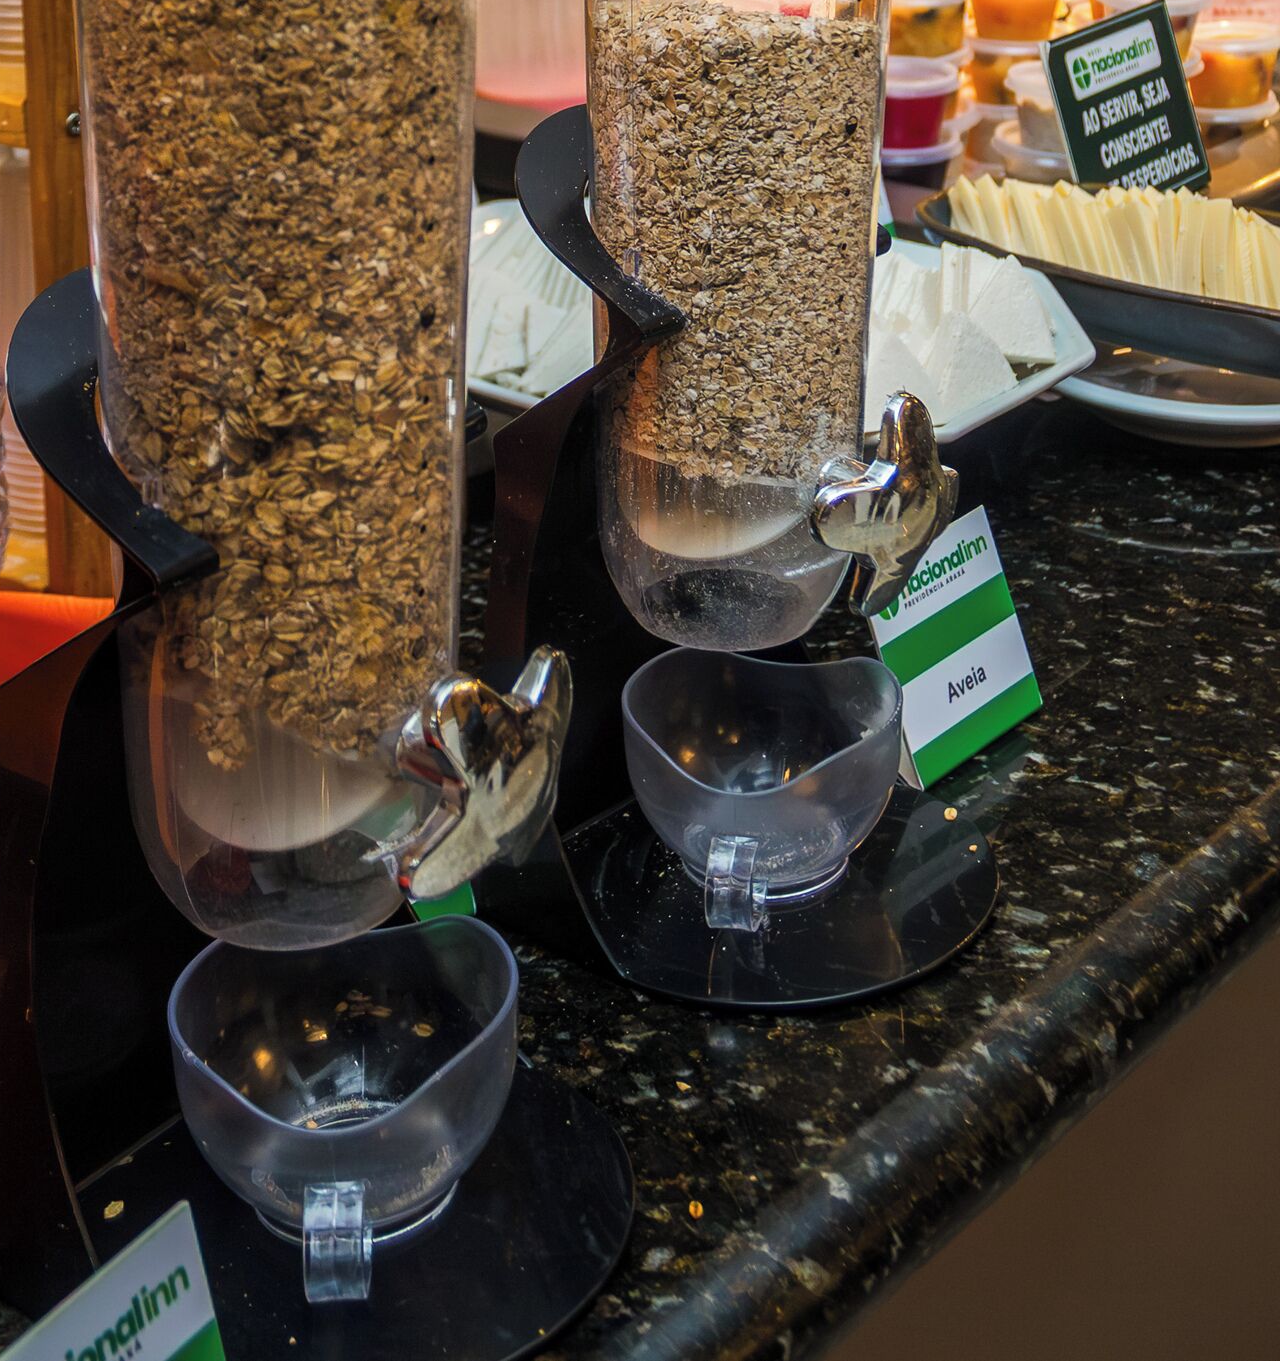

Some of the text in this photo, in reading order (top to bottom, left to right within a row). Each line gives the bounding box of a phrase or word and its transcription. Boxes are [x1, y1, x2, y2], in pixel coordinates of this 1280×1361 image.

[1082, 76, 1171, 137] AO SERVIR, SEJA
[1101, 114, 1172, 169] CONSCIENTE!
[904, 582, 945, 610] PREVIDÊNCIA
[947, 666, 987, 704] Aveia
